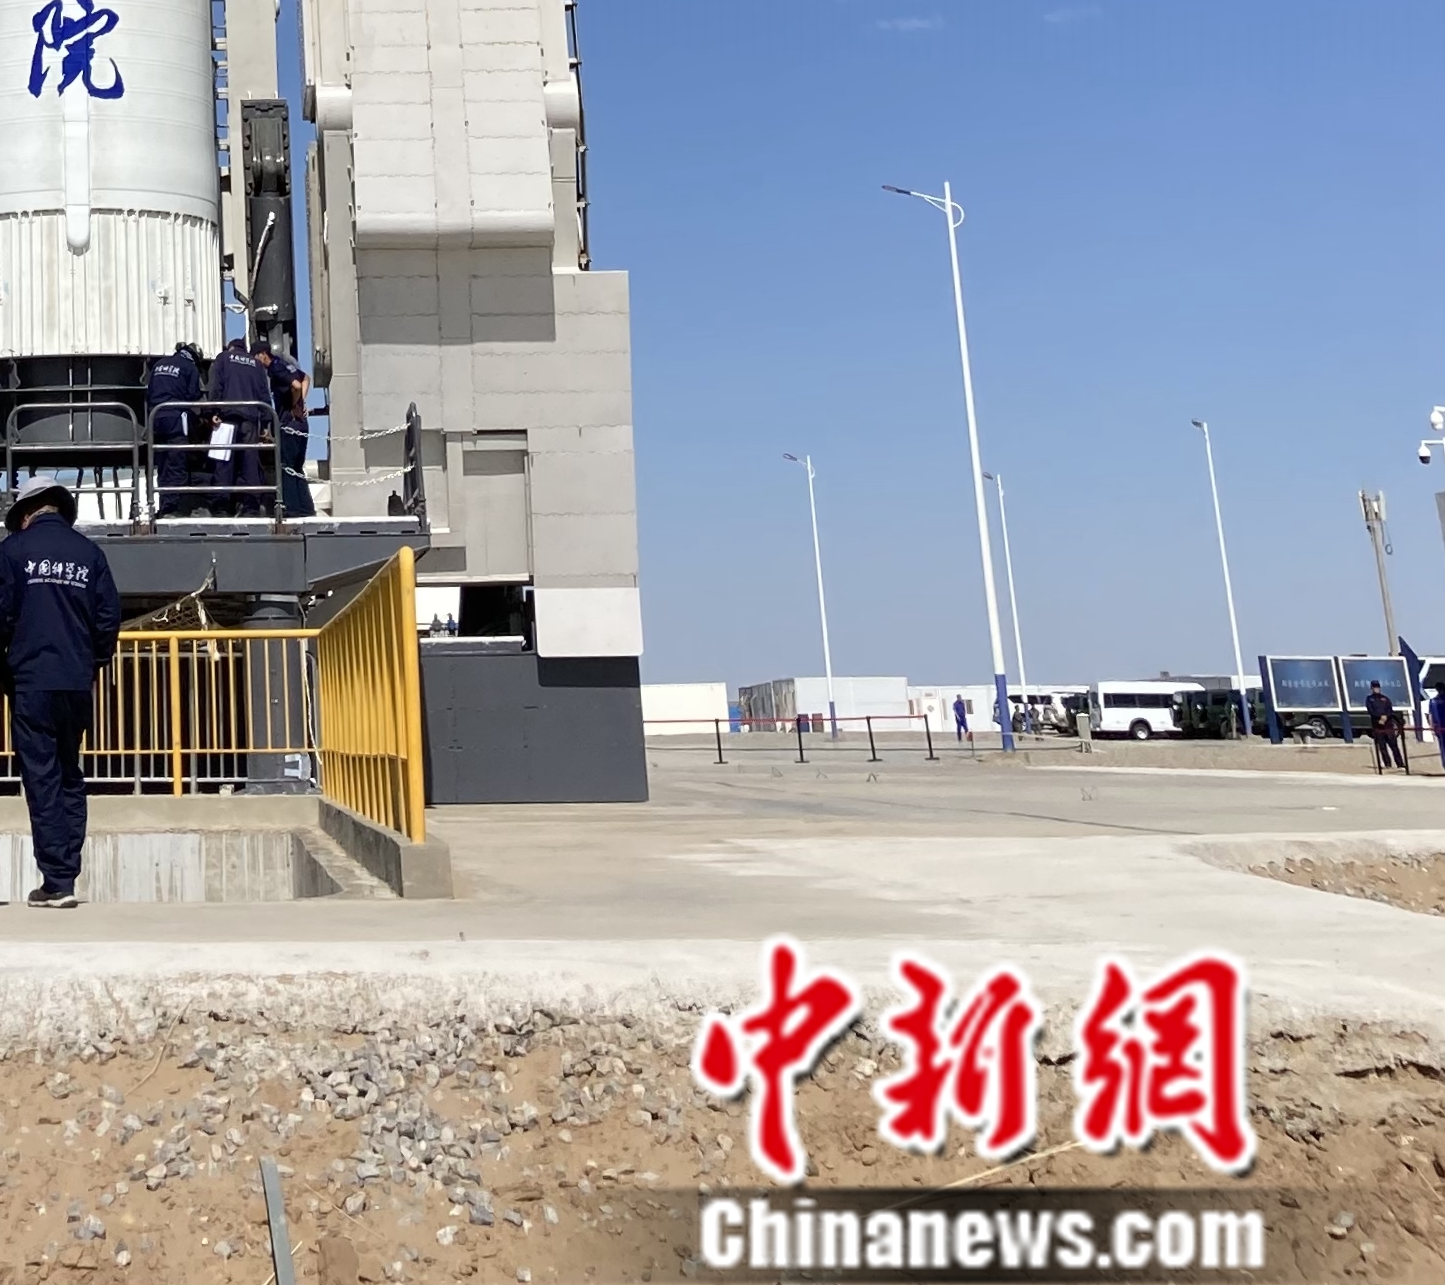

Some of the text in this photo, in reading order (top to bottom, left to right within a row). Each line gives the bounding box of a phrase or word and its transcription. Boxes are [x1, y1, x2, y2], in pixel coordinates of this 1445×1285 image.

[24, 559, 90, 583] 中国科学院
